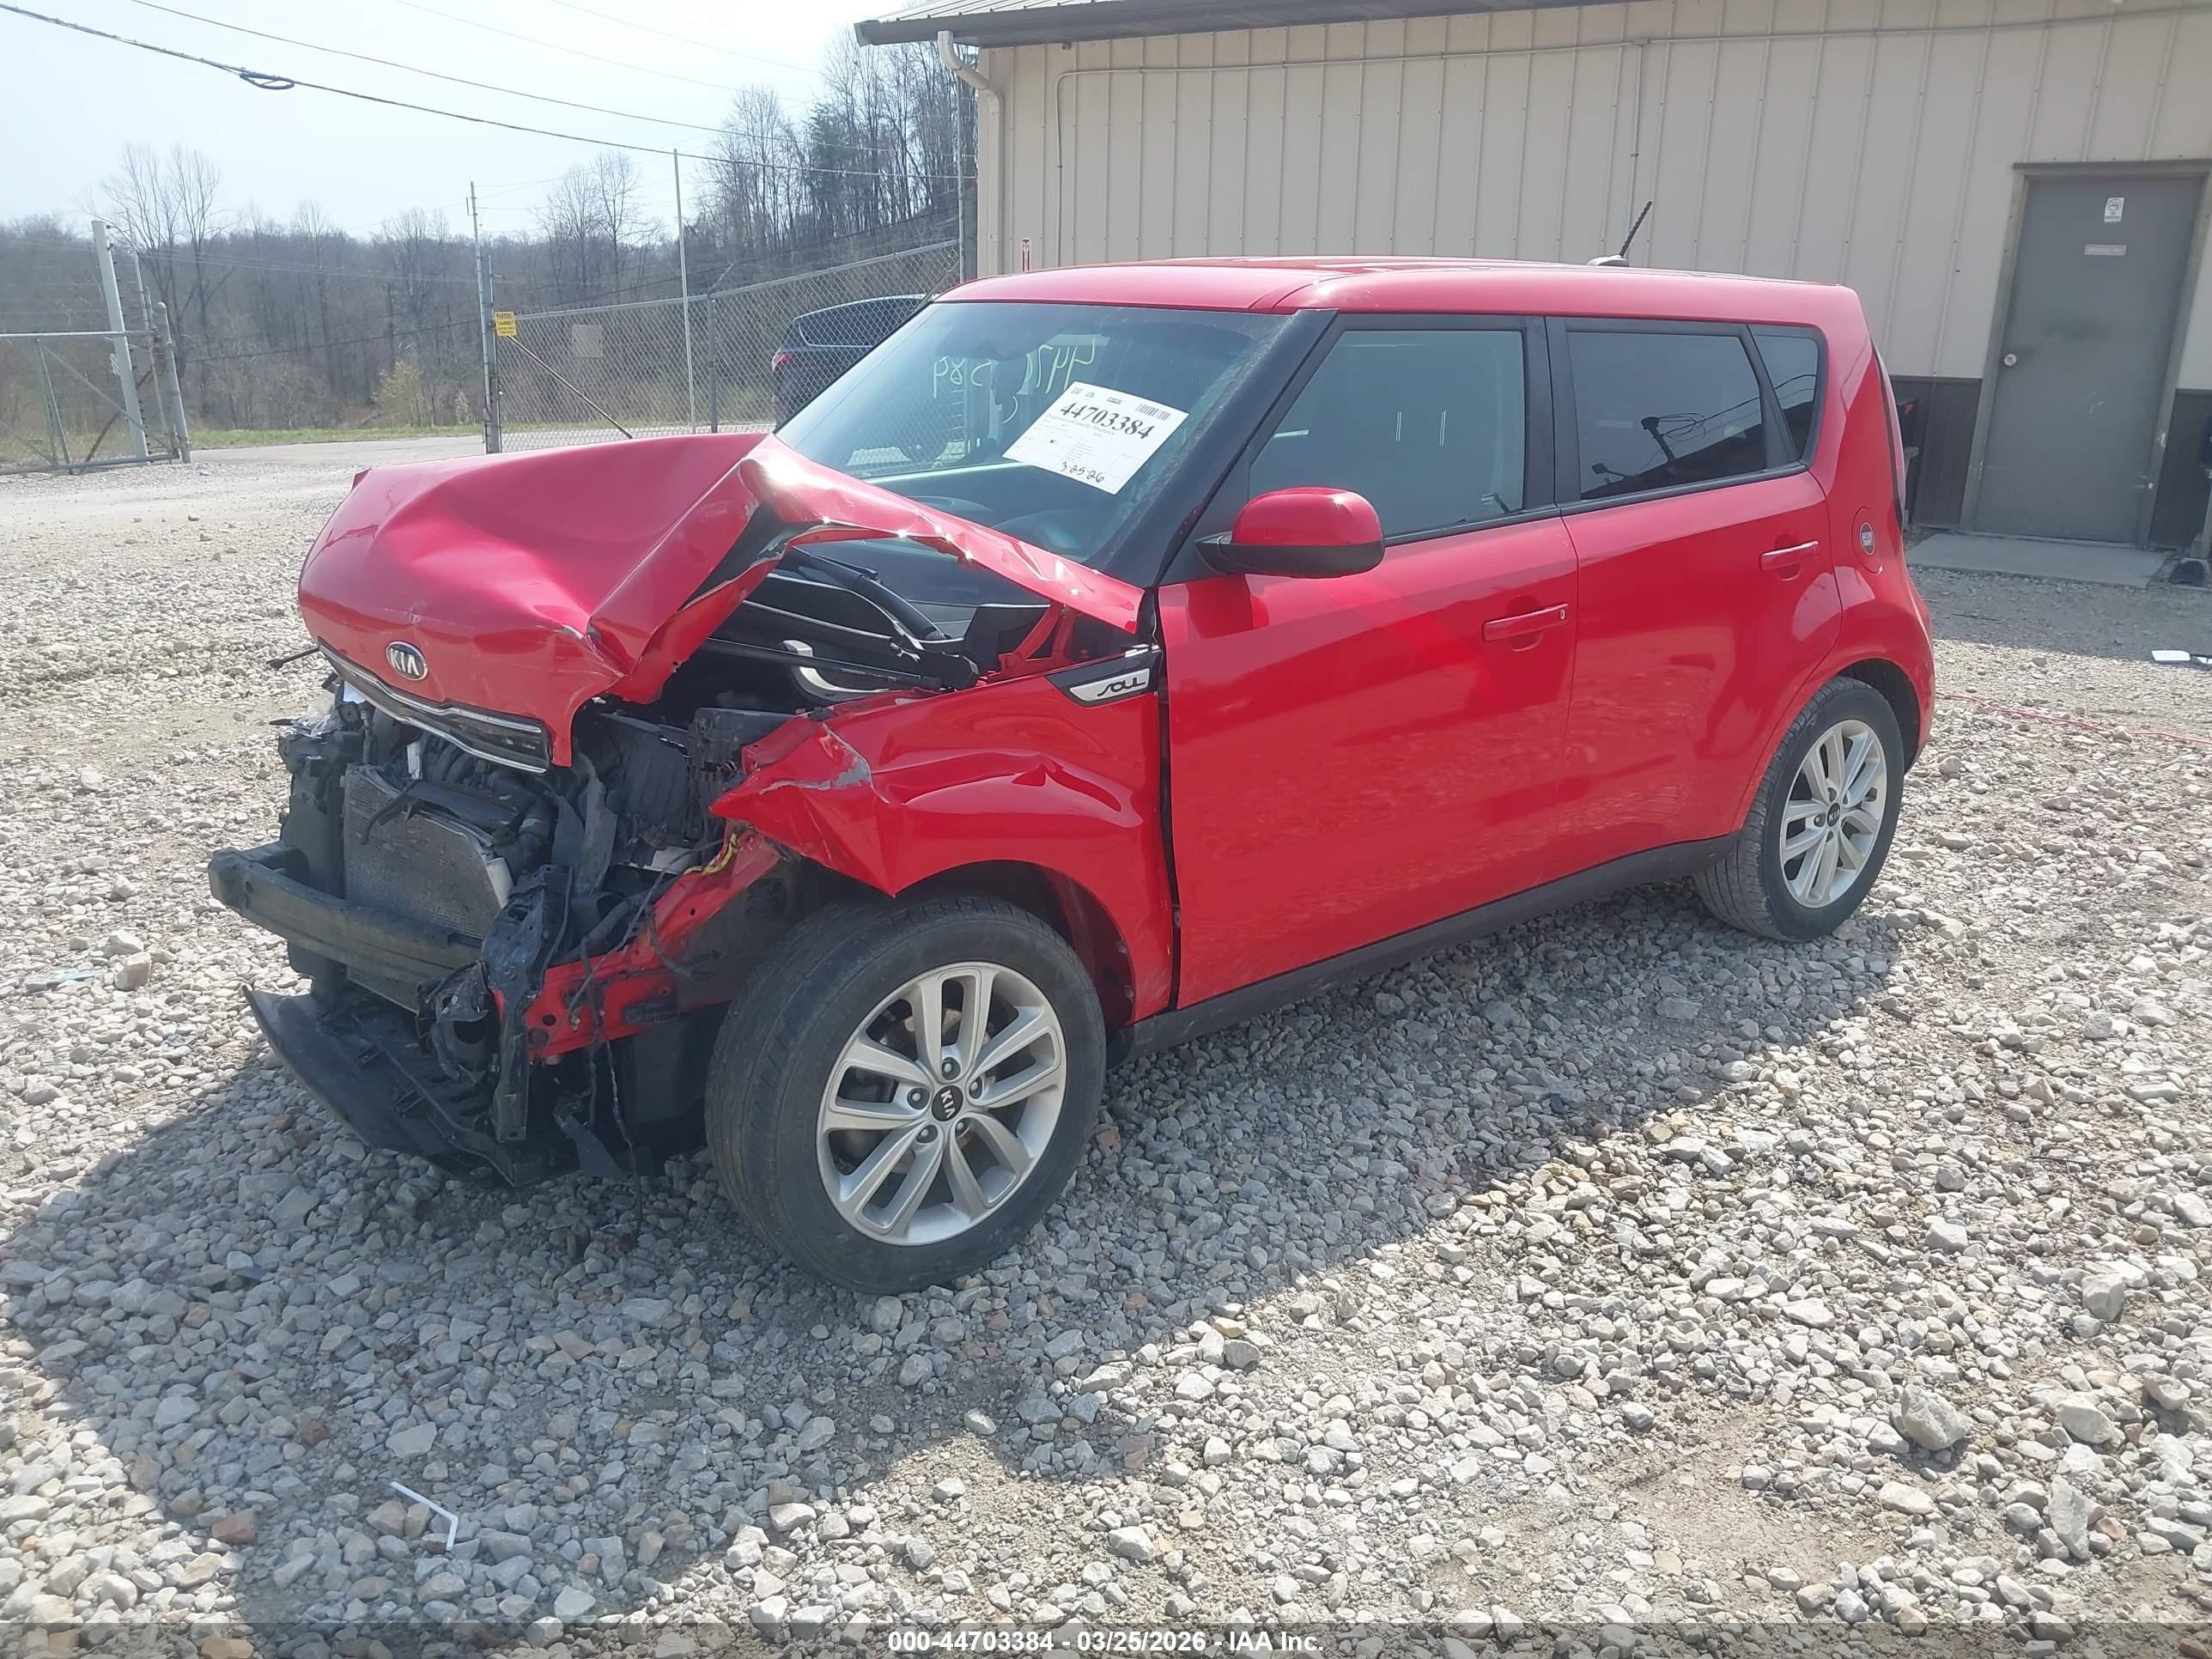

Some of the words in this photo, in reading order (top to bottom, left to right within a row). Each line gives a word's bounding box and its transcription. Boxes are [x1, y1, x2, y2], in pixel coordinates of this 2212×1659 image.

[1060, 403, 1154, 439] 44703384
[390, 647, 420, 677] KIA
[1097, 677, 1146, 696] SOUL
[940, 1089, 956, 1119] KIA
